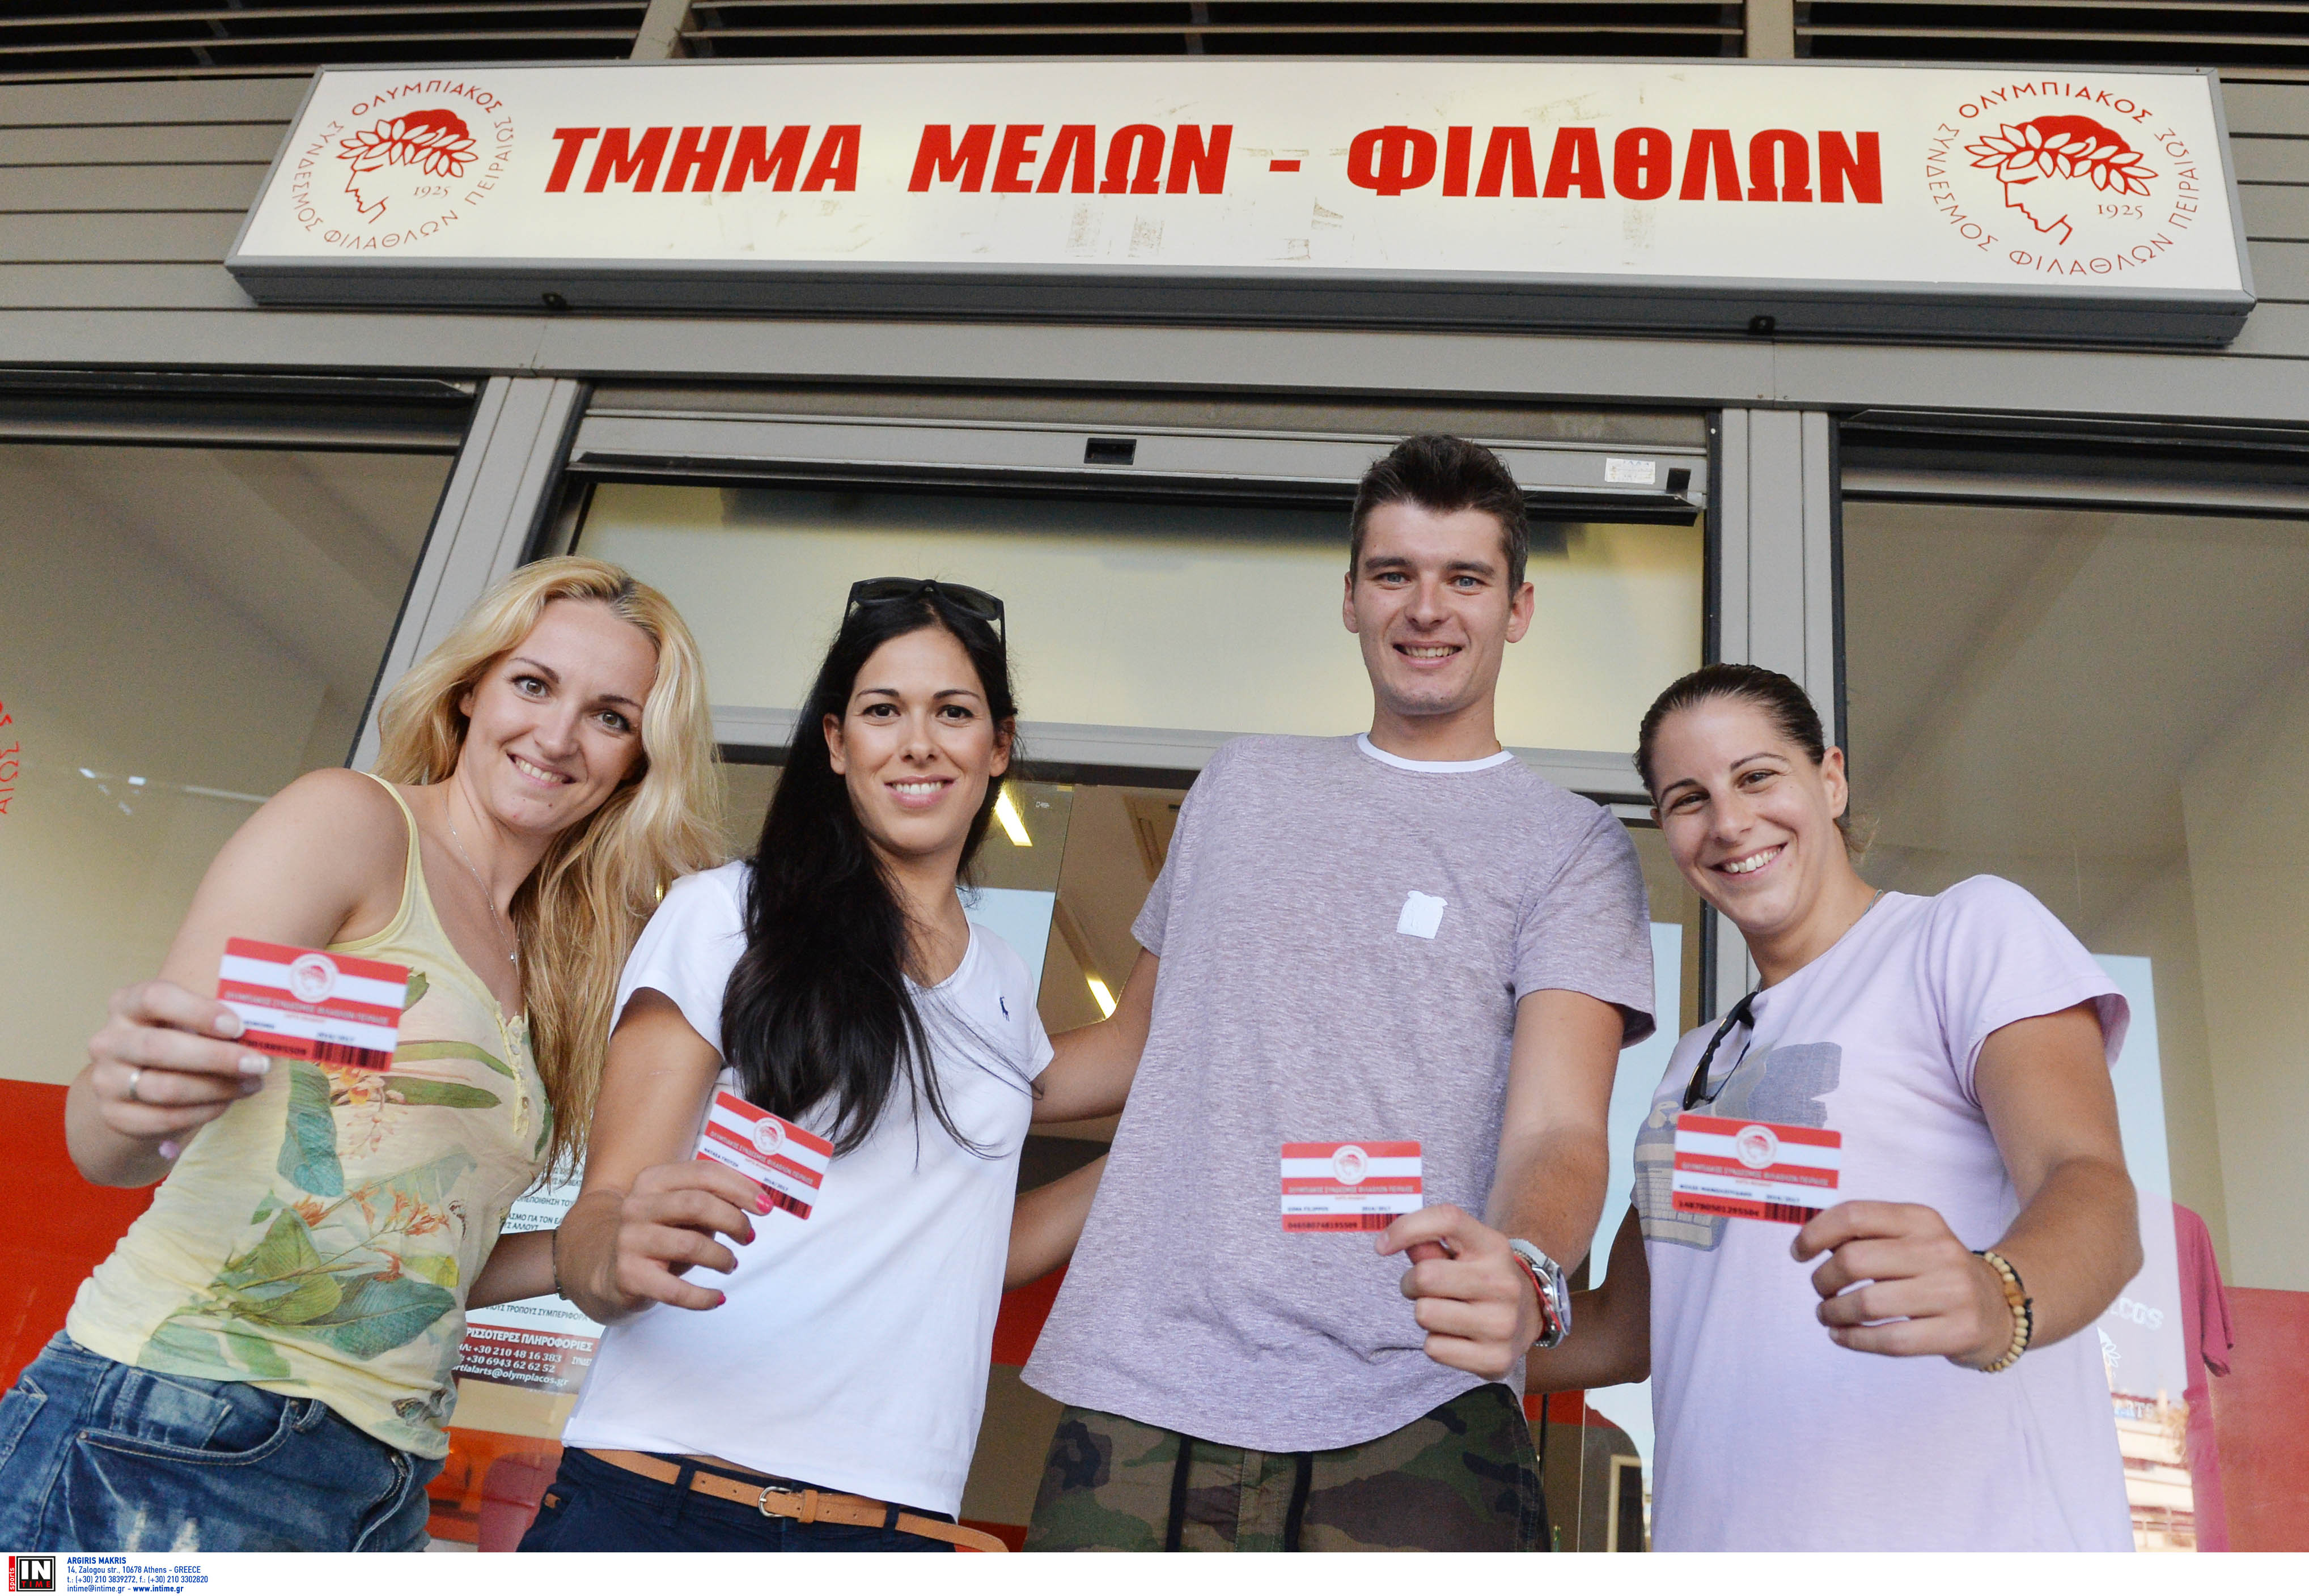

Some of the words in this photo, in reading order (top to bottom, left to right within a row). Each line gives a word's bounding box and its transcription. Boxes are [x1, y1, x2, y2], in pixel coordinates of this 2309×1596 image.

[351, 79, 503, 116] ΟΛΥΜΠΙΑΚΟΣ
[1959, 81, 2153, 124] ΟΛΥΜΠΙΑΚΟΣ
[545, 124, 861, 193] ΤΜΗΜΑ
[908, 124, 1234, 194] ΜΕΛΩΝ
[1347, 125, 1883, 204] ΦΙΛΑΘΛΩΝ
[291, 120, 345, 232] ΣΥΝΔΕΣΜΟΣ
[323, 209, 459, 249] ΦΙΛΑΘΛΩΝ
[464, 116, 515, 206] ΠΕΙΡΑΙΩΣ
[413, 185, 452, 199] 1925
[1926, 123, 1998, 252] ΣΥΝΔΕΣΜΟΣ
[2009, 232, 2174, 275] ΦΙΛΑΘΛΩΝ
[2154, 128, 2200, 230] ΠΕΙΡΑΙΩΣ
[2097, 203, 2144, 219] 1925
[492, 1347, 512, 1357] 210
[513, 1349, 527, 1359] 48
[527, 1351, 541, 1360] 16
[541, 1352, 562, 1363] 383
[520, 1333, 594, 1352] ΠΛΗΡΟΦΟΡΙΕΣ
[486, 1357, 512, 1368] 6943
[512, 1360, 527, 1369] 62
[527, 1362, 541, 1371] 62
[541, 1364, 556, 1373] 52
